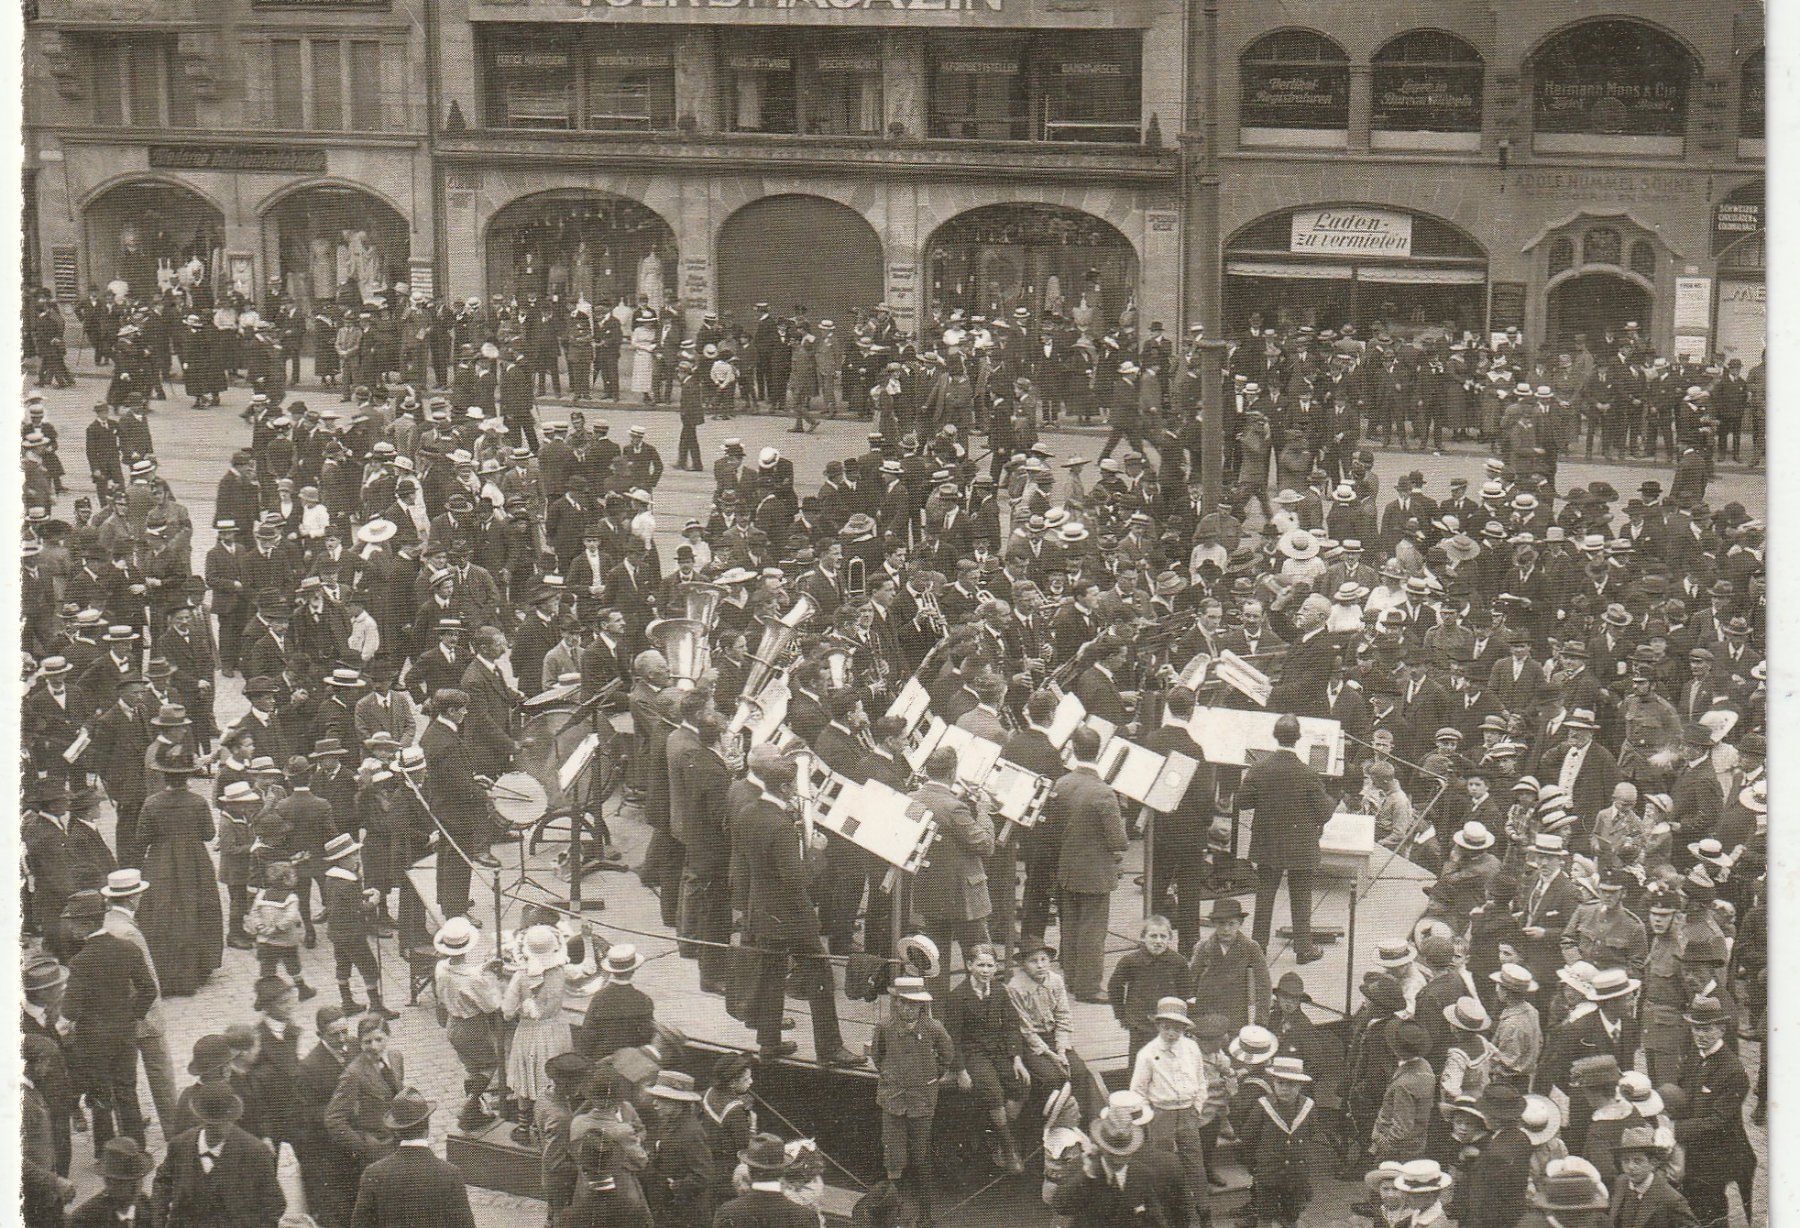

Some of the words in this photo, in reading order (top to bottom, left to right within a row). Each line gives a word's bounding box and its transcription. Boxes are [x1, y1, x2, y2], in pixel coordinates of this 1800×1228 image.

[1544, 80, 1603, 97] Hermann
[1296, 233, 1318, 247] zu
[1320, 233, 1408, 250] vermieten
